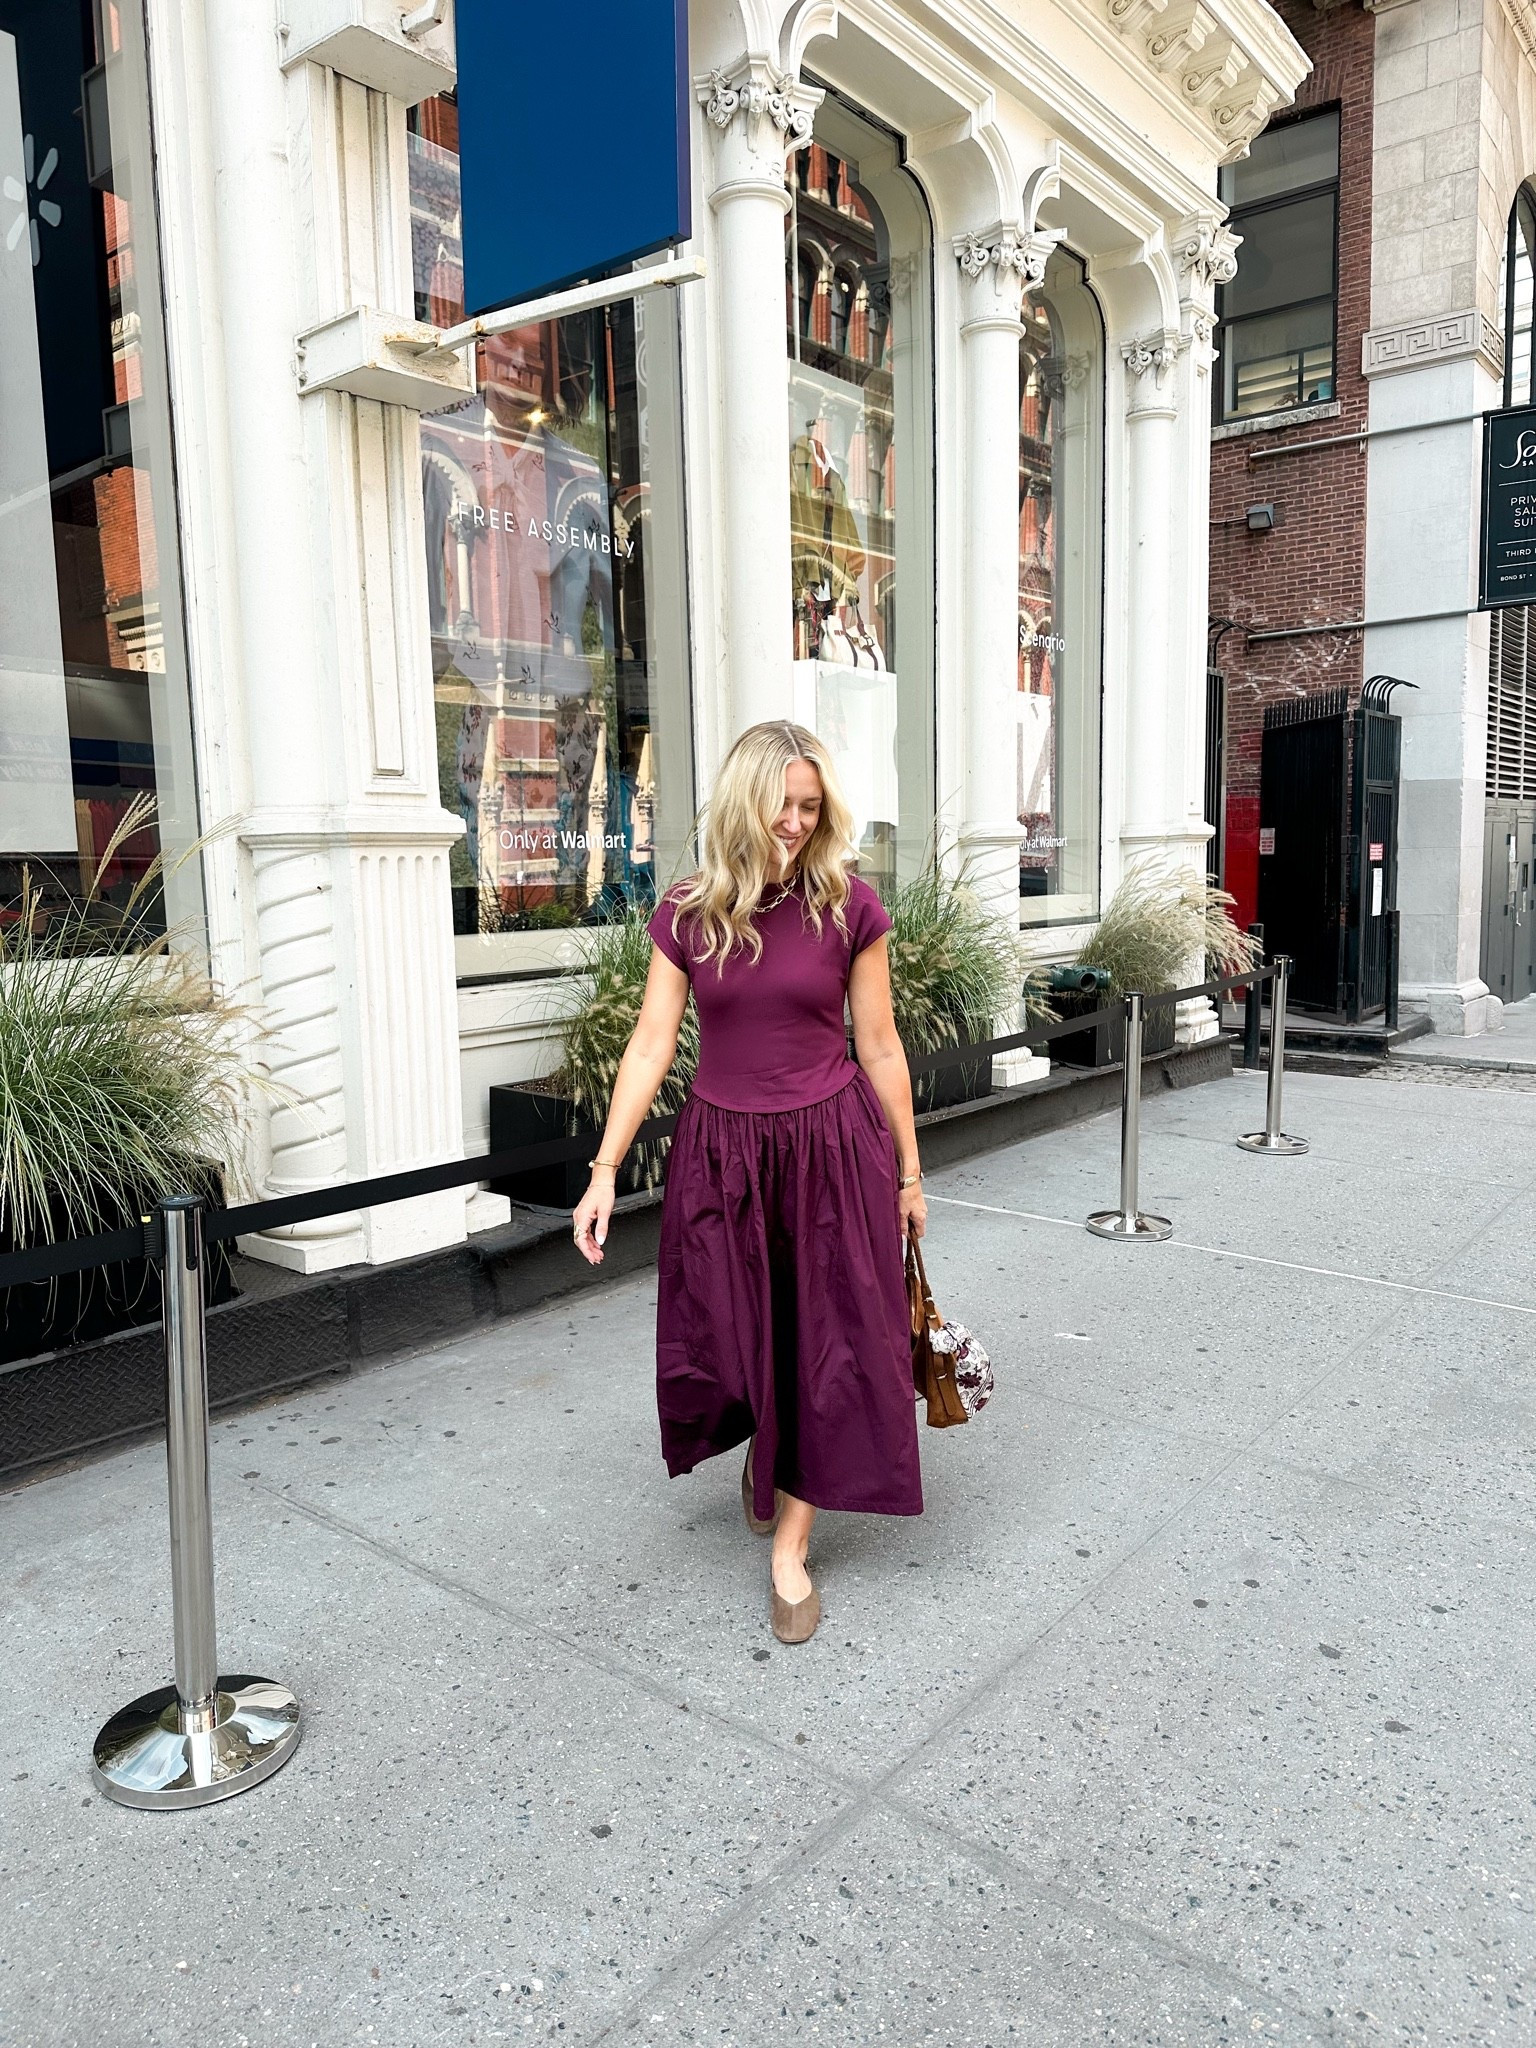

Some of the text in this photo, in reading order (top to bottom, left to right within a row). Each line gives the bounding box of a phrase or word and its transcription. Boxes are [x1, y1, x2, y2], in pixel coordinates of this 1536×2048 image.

[1513, 517, 1536, 528] SUI
[457, 501, 635, 559] FREE ASSEMBLY
[1505, 548, 1532, 558] THIRD
[1500, 574, 1518, 582] BOND
[500, 830, 627, 854] Only at Walmart
[1039, 835, 1068, 848] Walmart
